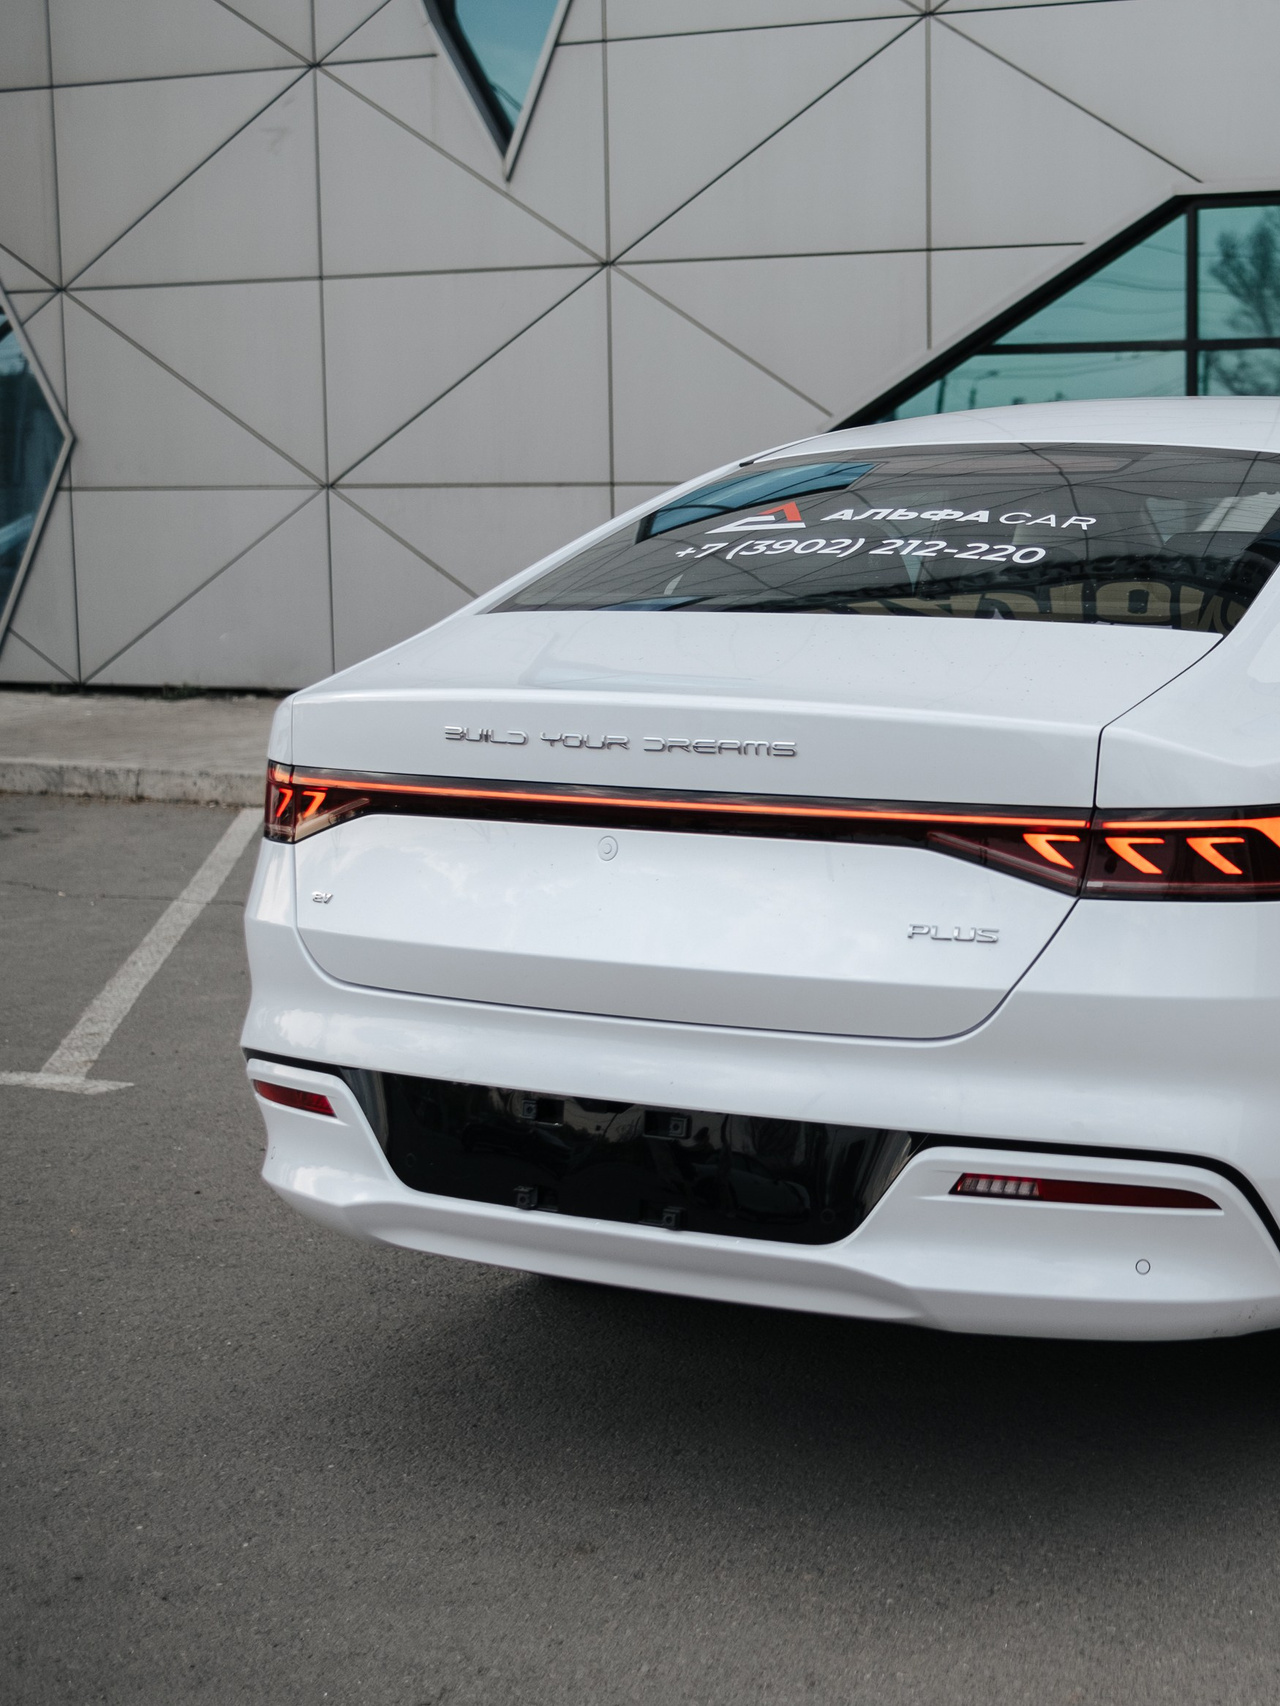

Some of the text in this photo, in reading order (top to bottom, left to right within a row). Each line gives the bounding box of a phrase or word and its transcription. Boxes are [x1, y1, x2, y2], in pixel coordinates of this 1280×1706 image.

[675, 537, 1047, 565] +7 (3902) 212-220
[444, 725, 799, 758] BUILD YOUR DREAMS
[907, 923, 1000, 944] PLUS
